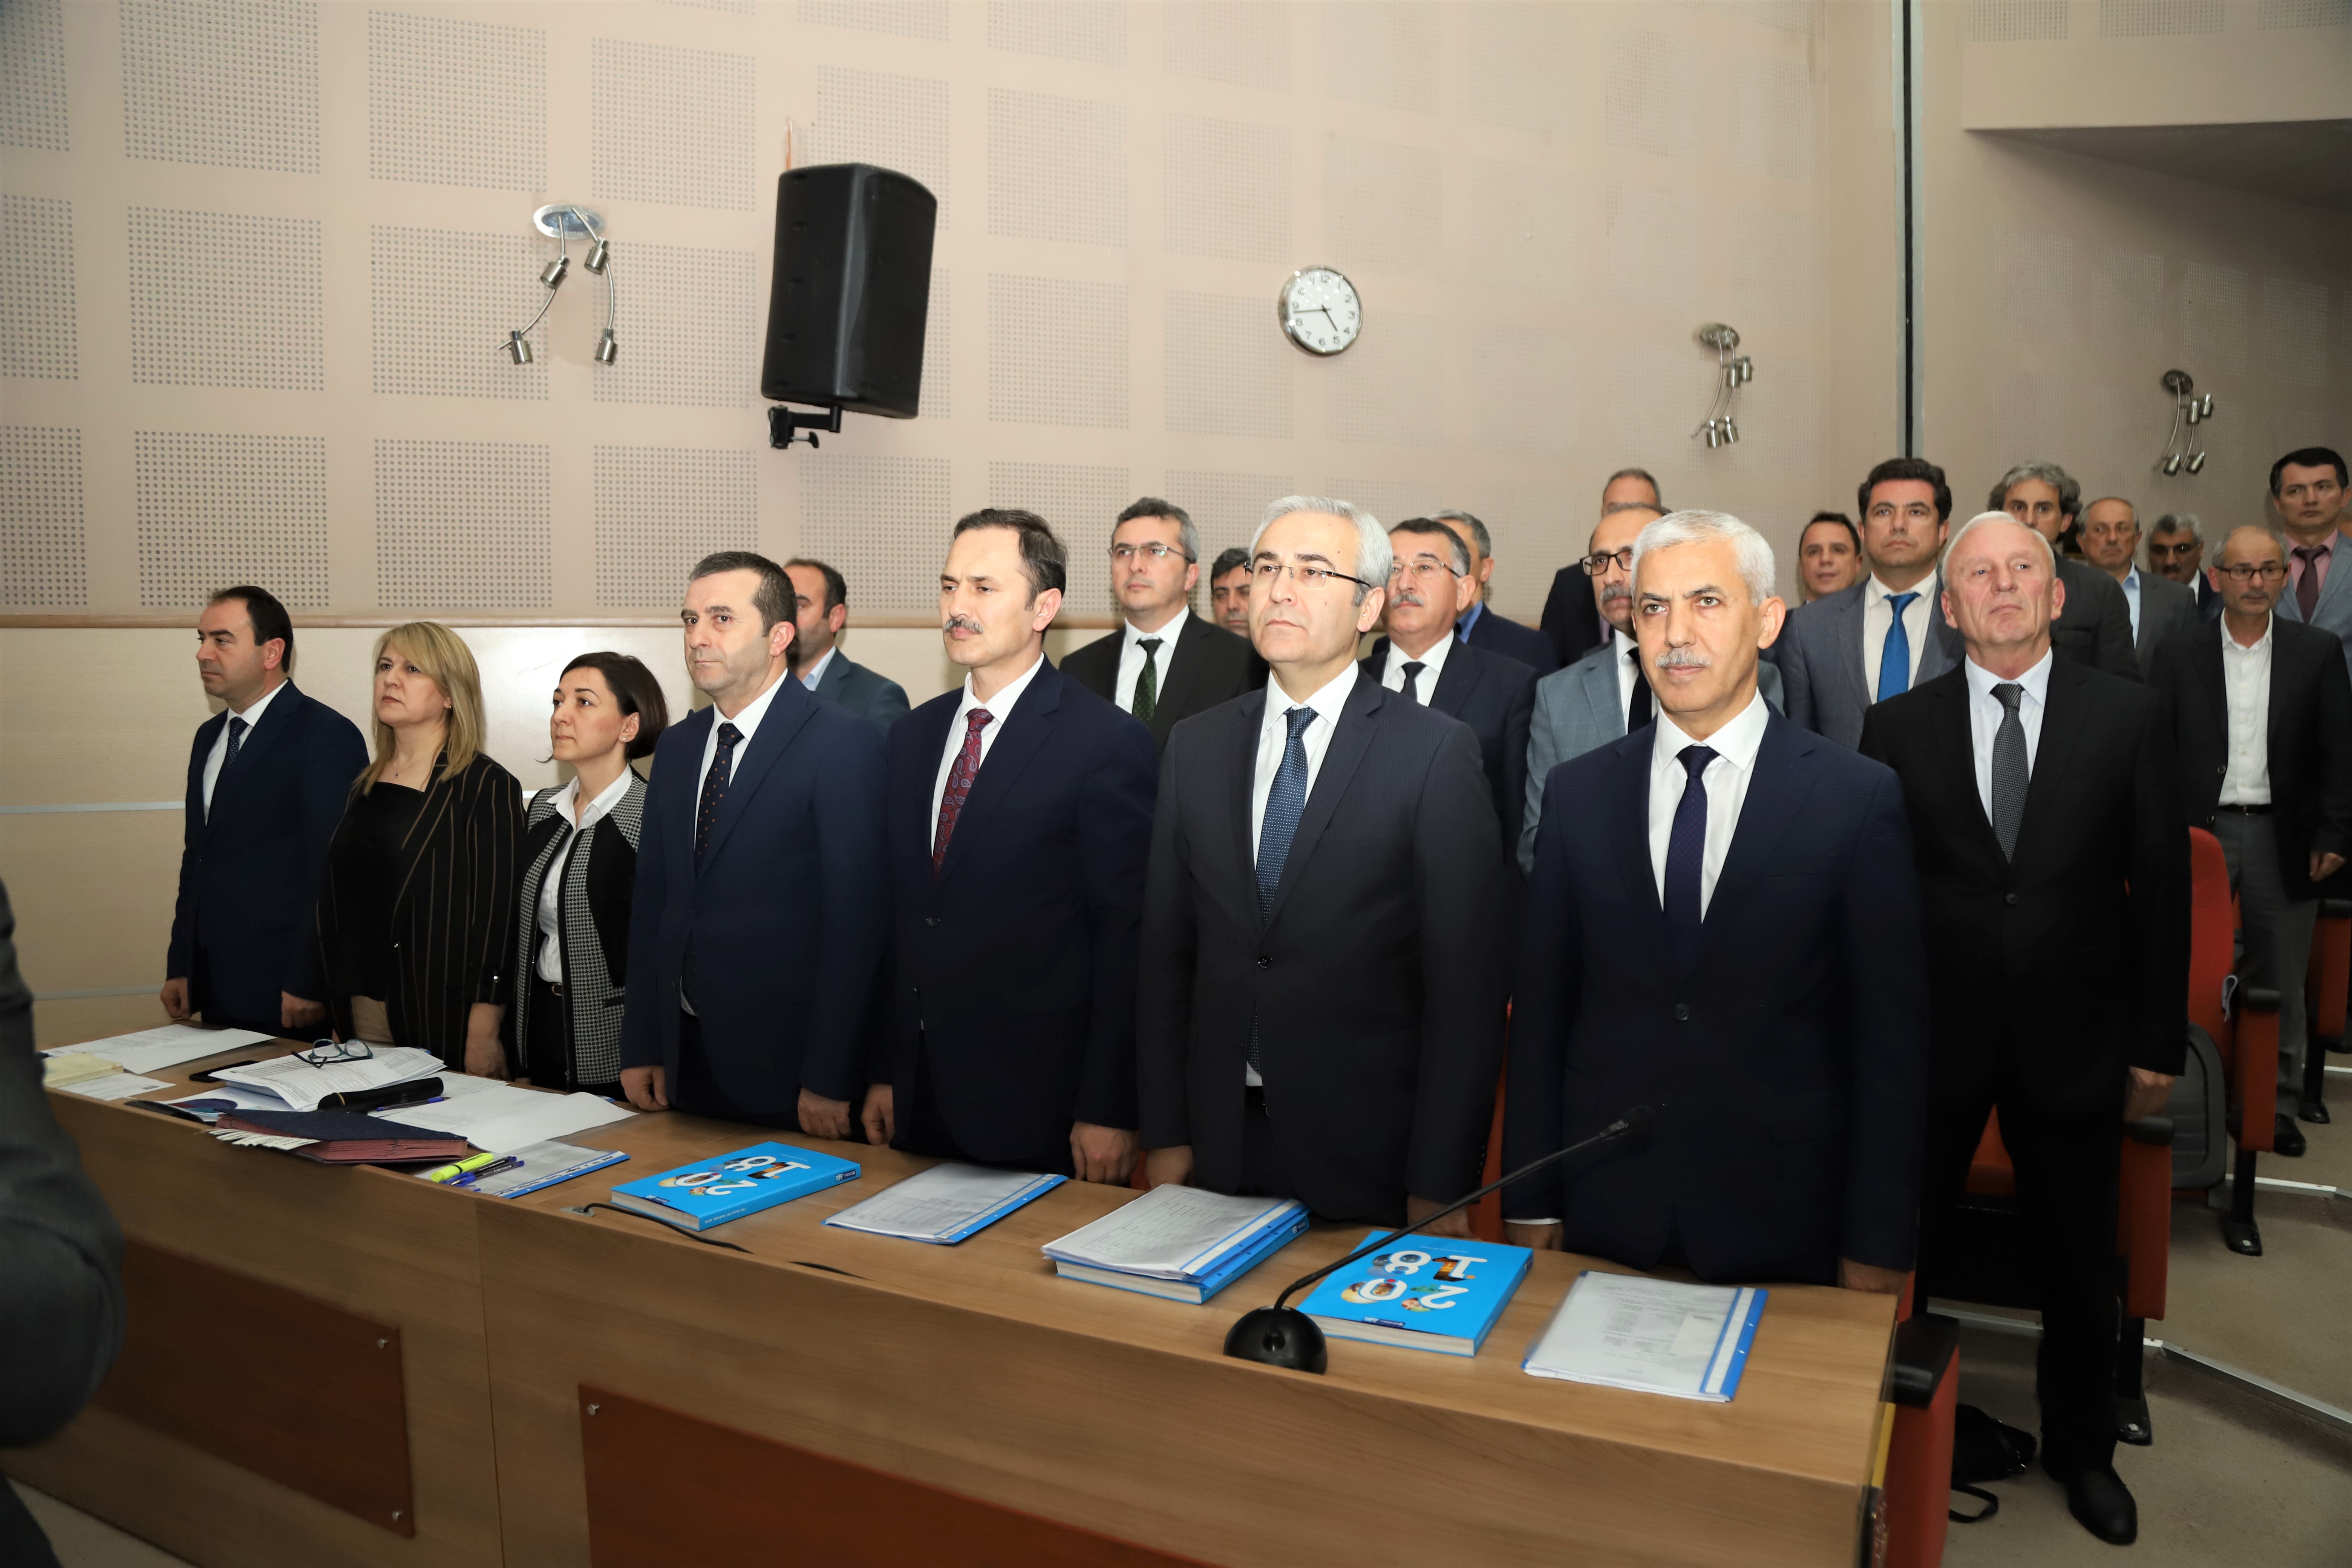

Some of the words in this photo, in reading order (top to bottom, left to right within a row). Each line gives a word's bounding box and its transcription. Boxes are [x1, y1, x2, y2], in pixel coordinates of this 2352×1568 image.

[1309, 276, 1315, 285] 11
[1321, 275, 1331, 283] 12
[1345, 294, 1352, 303] 2
[1348, 311, 1355, 319] 3
[1295, 318, 1303, 326] 8
[1305, 331, 1312, 339] 7
[1333, 335, 1340, 344] 5
[1319, 338, 1326, 346] 6
[724, 1156, 810, 1179] 18
[675, 1172, 758, 1196] 20
[1384, 1250, 1488, 1279] 18
[1359, 1278, 1469, 1309] 20
